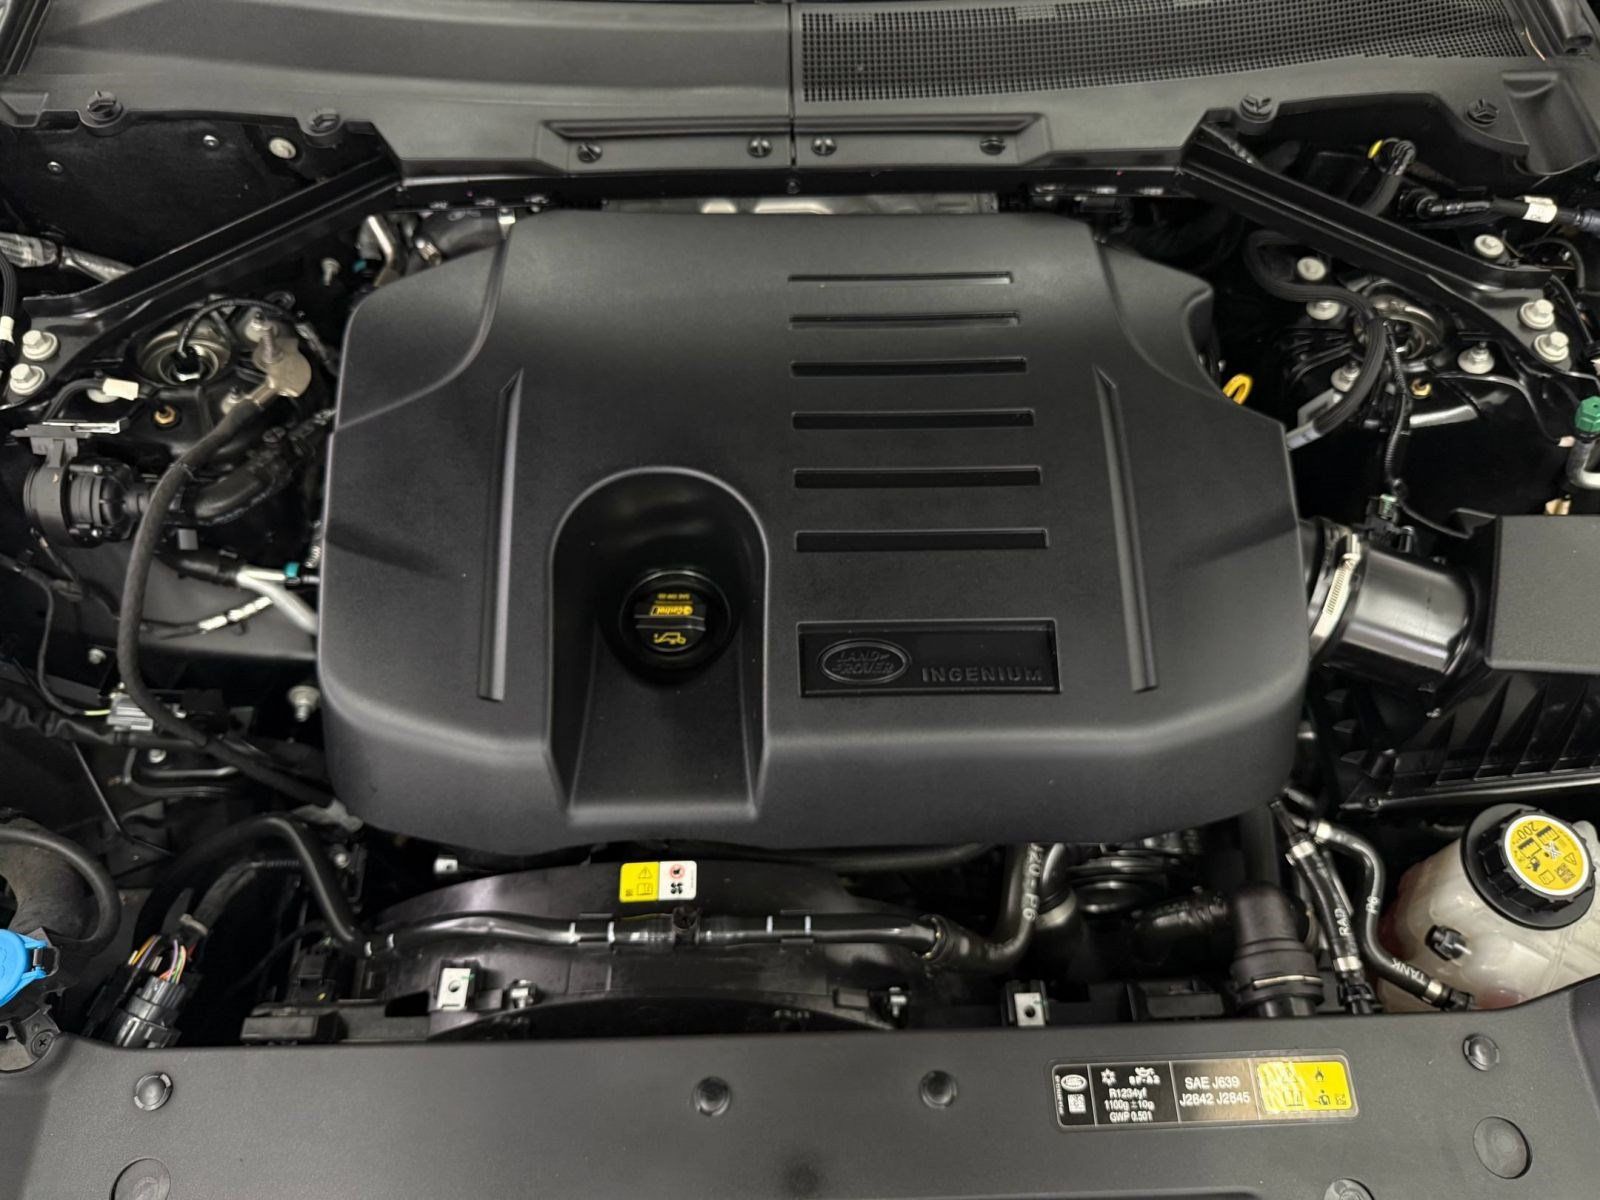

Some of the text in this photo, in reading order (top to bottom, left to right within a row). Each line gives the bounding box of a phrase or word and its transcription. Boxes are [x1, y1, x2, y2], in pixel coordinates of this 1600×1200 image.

[922, 666, 1042, 682] INGENIUM
[1516, 822, 1537, 840] 200
[1334, 908, 1351, 936] RAD
[1392, 957, 1428, 986] TANK
[1184, 1075, 1240, 1090] SAE J639
[1109, 1087, 1147, 1099] R1234yf
[1104, 1099, 1130, 1111] 1100g
[1109, 1110, 1153, 1123] GWP 0.501
